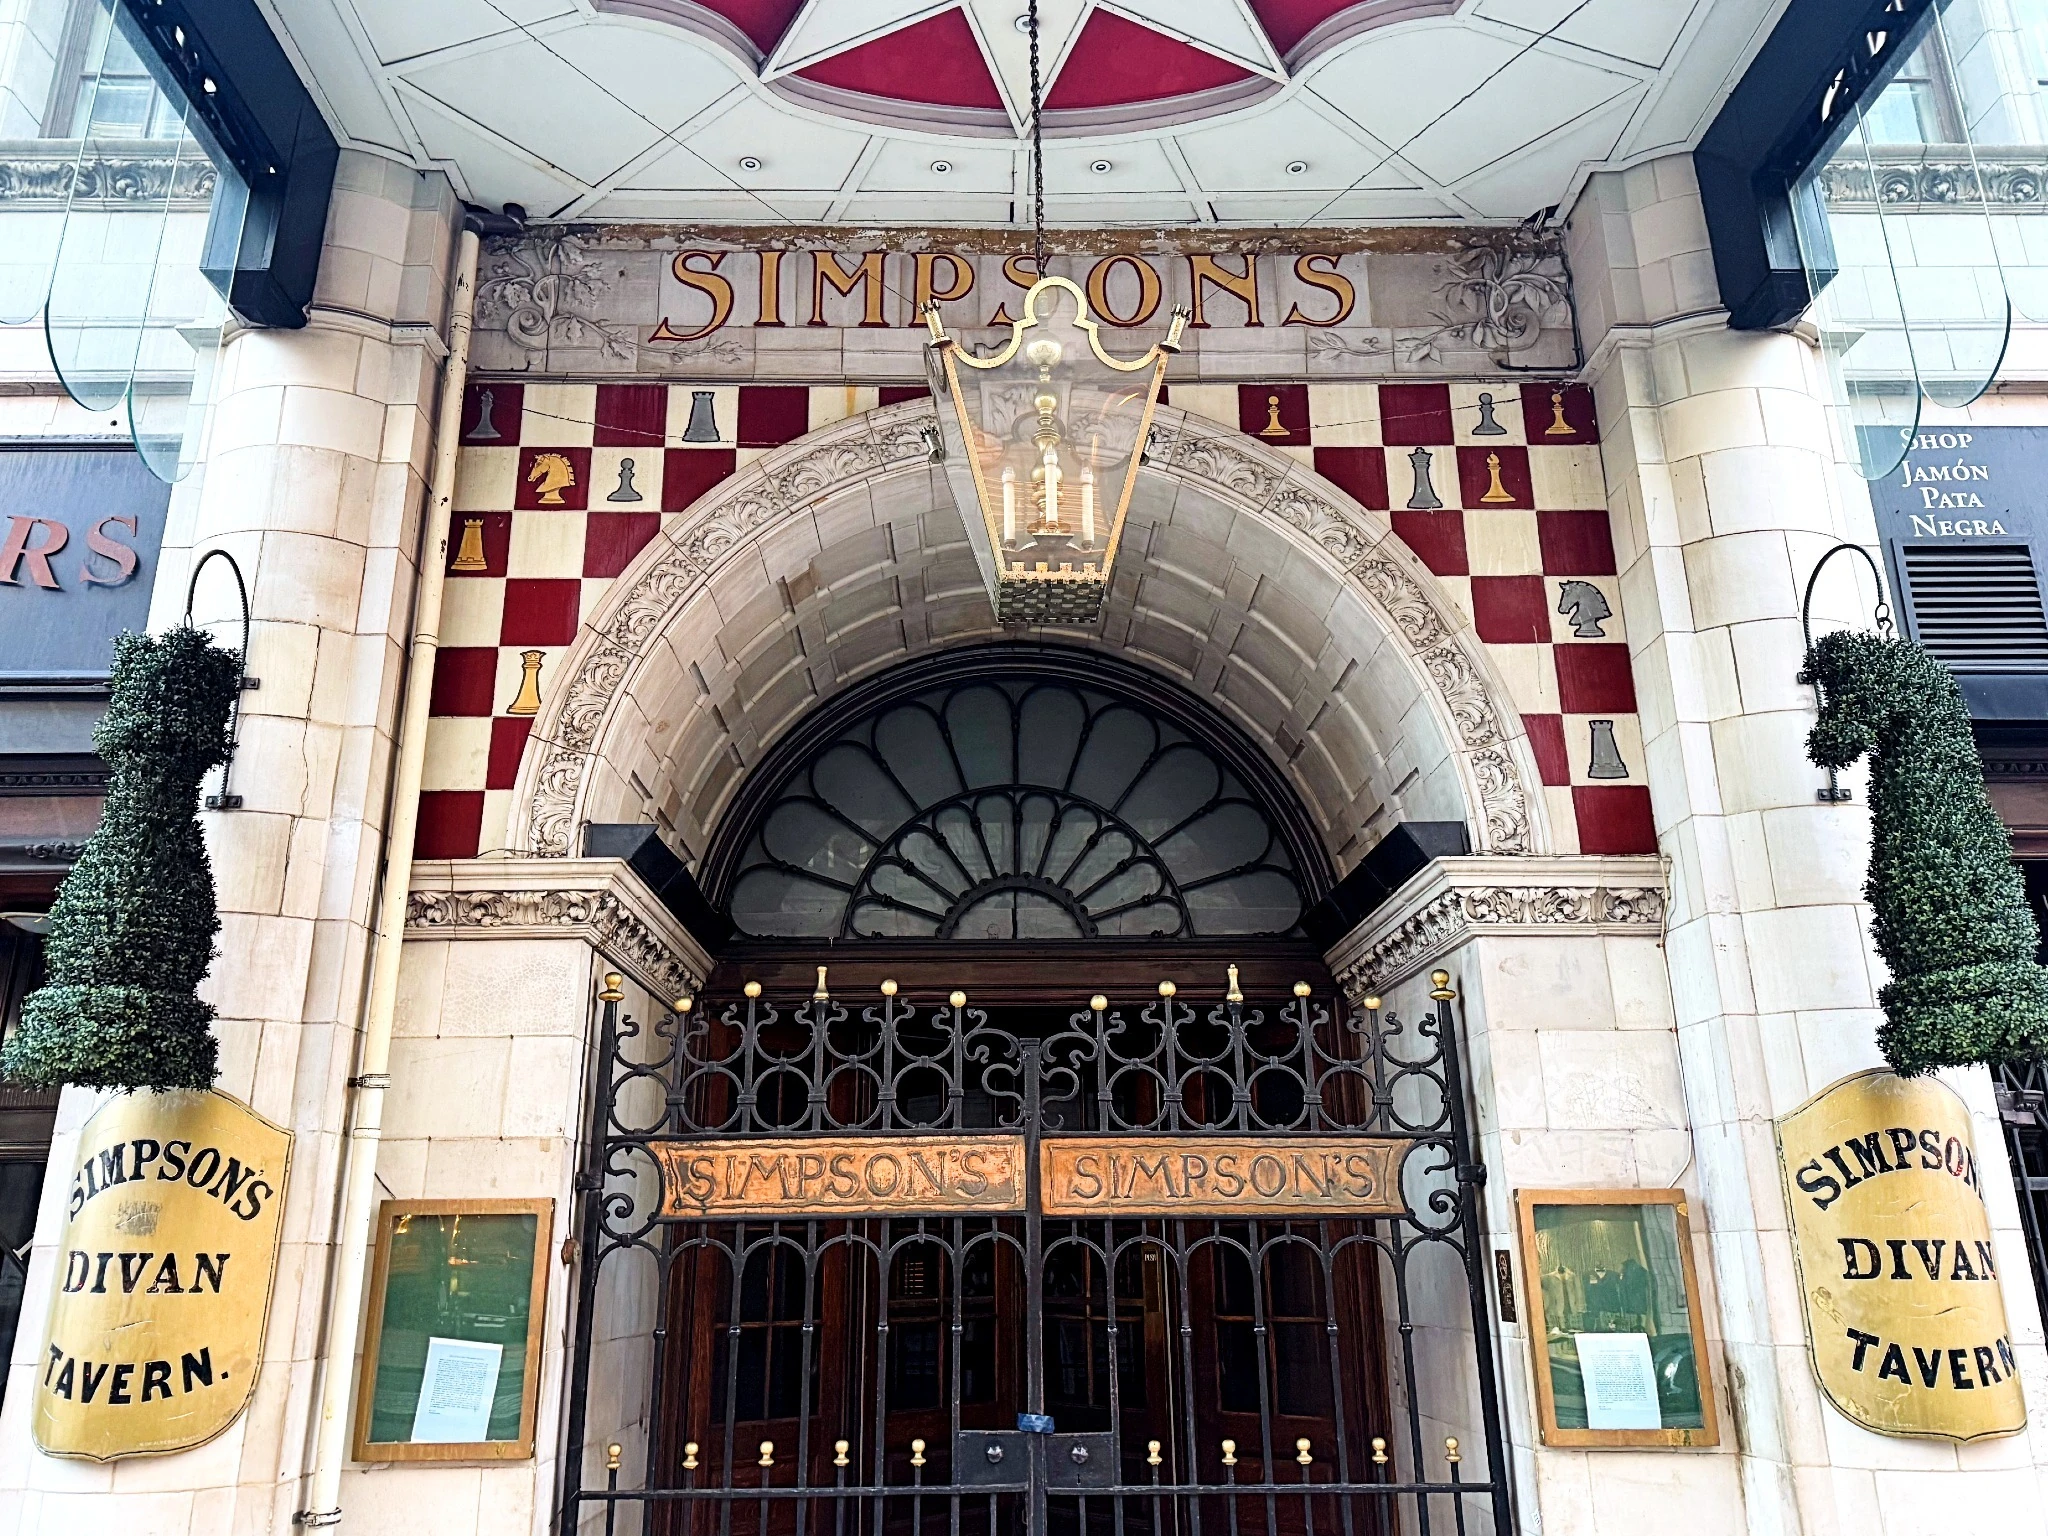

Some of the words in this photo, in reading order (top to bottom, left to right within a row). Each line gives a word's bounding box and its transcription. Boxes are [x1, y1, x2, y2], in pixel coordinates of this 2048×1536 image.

[648, 250, 1356, 342] SIMPSONS
[1900, 427, 1973, 450] SHOP
[1901, 457, 1989, 488] JAMÓN
[1919, 486, 1985, 509] PATA
[1909, 514, 2008, 537] NEGRA
[69, 1138, 274, 1223] SIMPSON'S
[683, 1150, 988, 1201] SIMPSON'S
[1071, 1152, 1374, 1200] SIMPSON'S
[62, 1250, 230, 1294] DIVAN
[1837, 1238, 1996, 1281] DIVAN
[43, 1342, 229, 1405] TAVERN.
[1846, 1327, 2017, 1390] TAVERN
